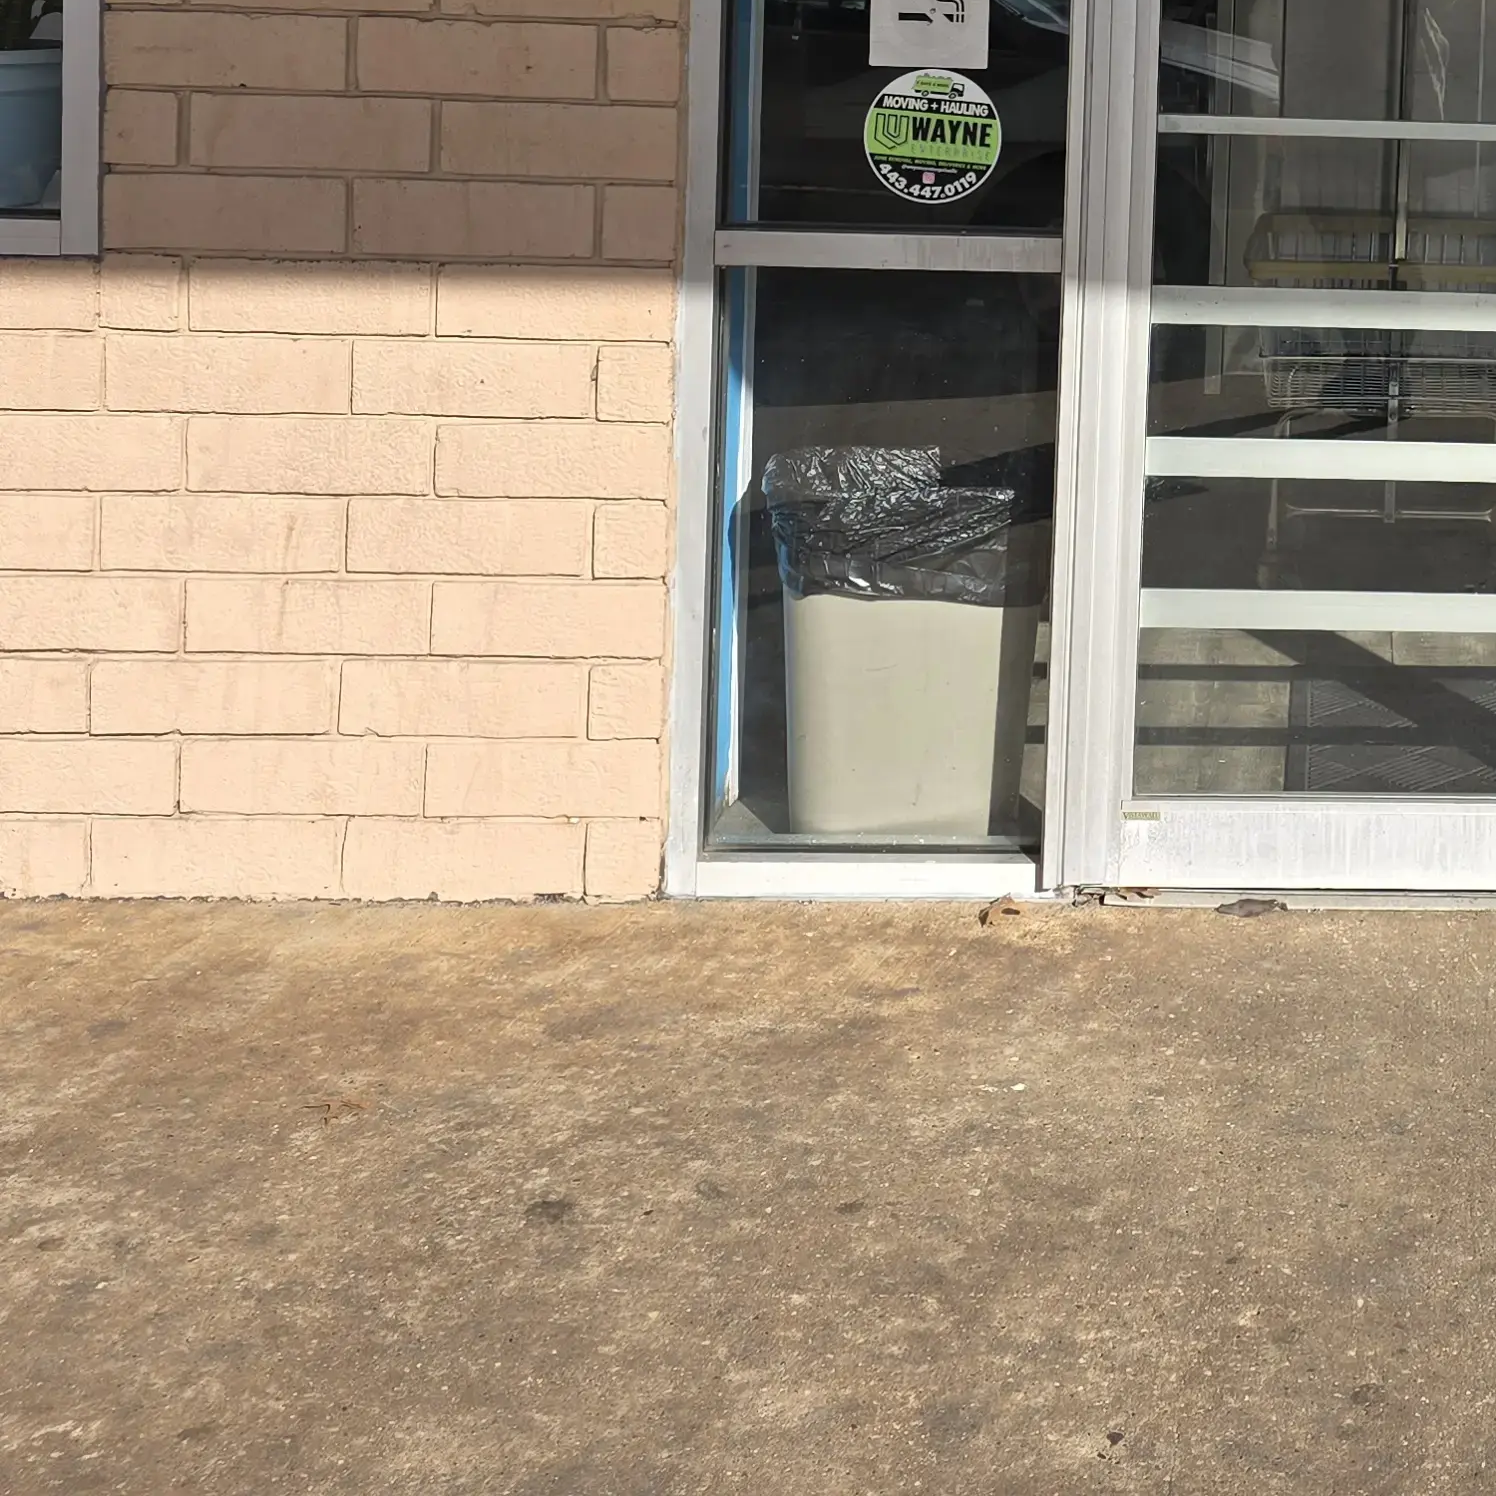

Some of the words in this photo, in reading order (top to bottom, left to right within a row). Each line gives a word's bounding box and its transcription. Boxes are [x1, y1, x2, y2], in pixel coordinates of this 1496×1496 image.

[882, 95, 929, 111] MOVING
[940, 101, 989, 117] HAULING
[912, 116, 993, 148] WAYNE
[879, 164, 977, 198] 443.447.0119
